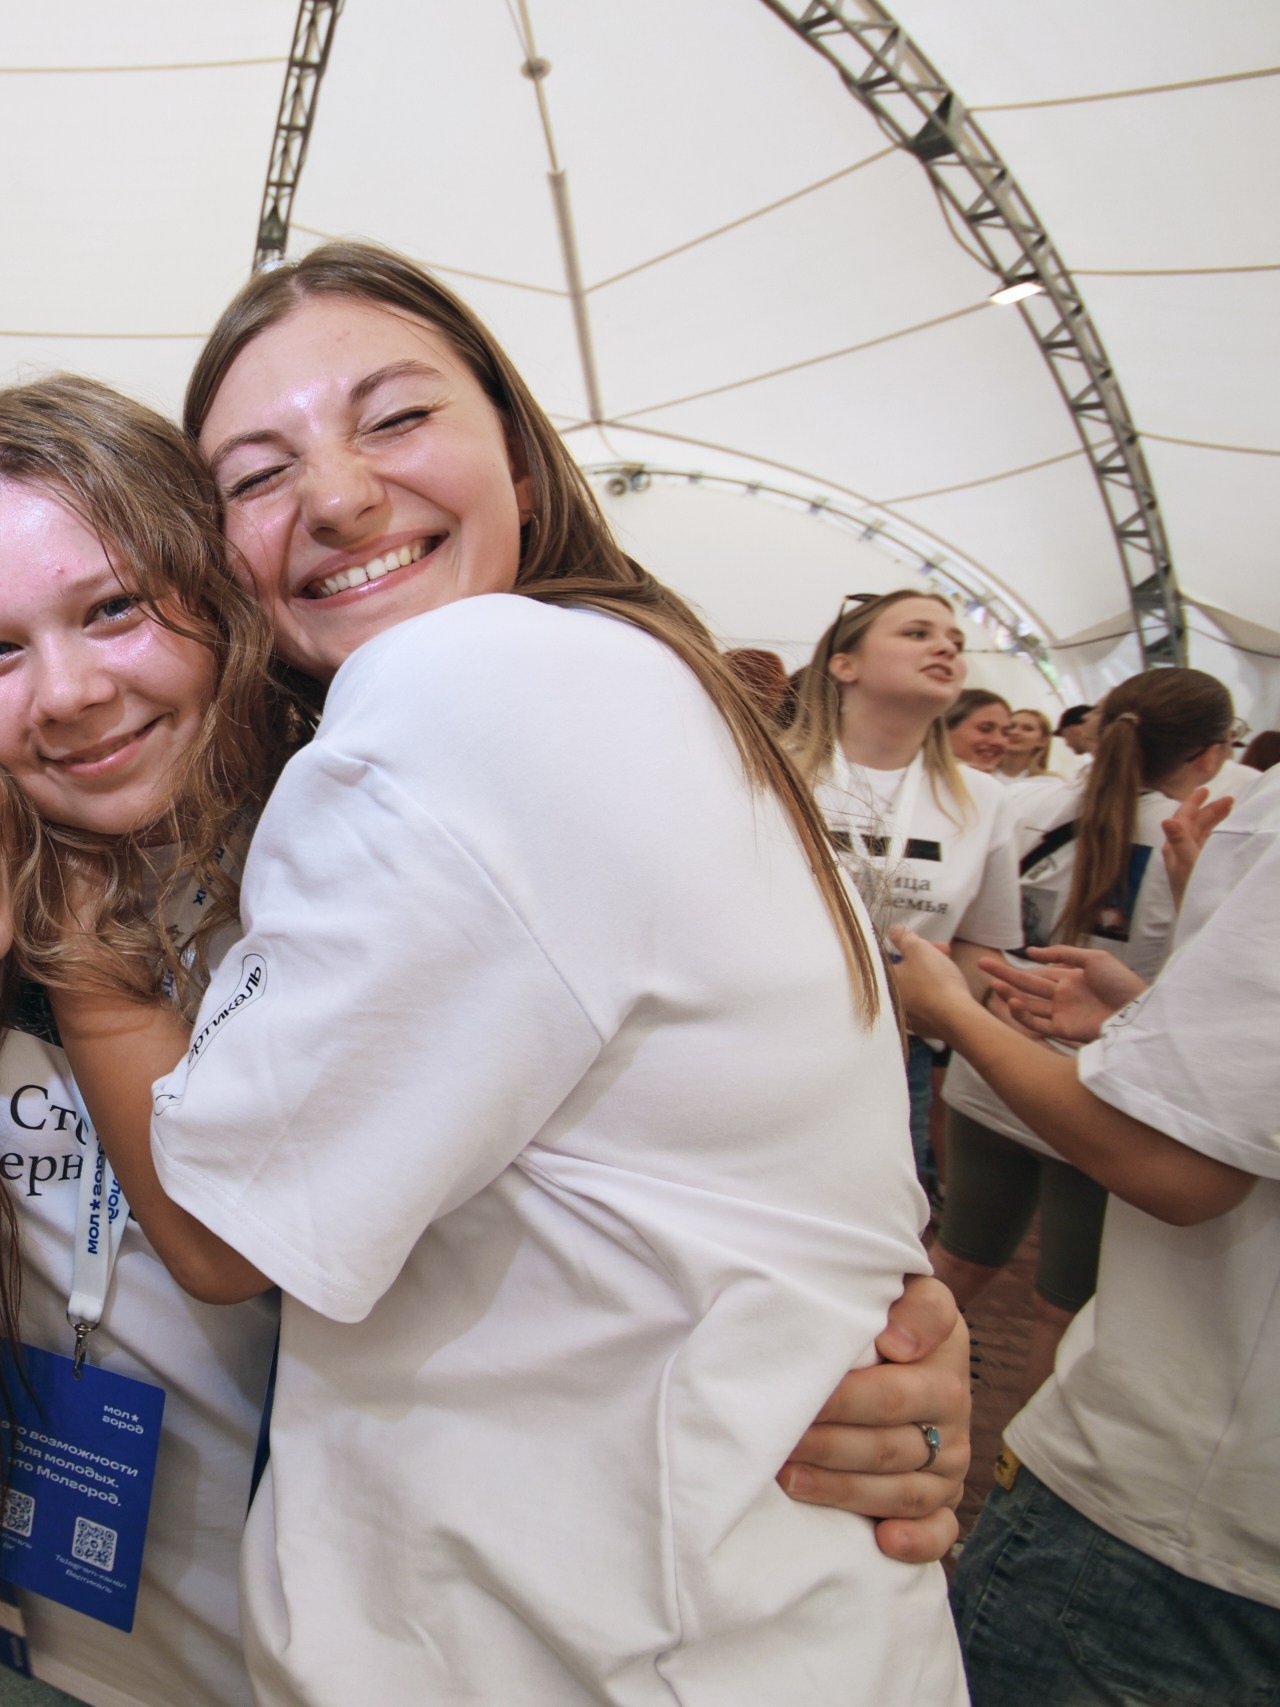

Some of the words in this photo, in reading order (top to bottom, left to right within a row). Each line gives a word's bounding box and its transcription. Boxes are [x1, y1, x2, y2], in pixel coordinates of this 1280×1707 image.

[102, 1415, 145, 1435] город
[14, 1440, 42, 1458] для
[44, 1453, 120, 1488] молодых.
[29, 1431, 139, 1477] возможности
[36, 1465, 122, 1507] Молгород.
